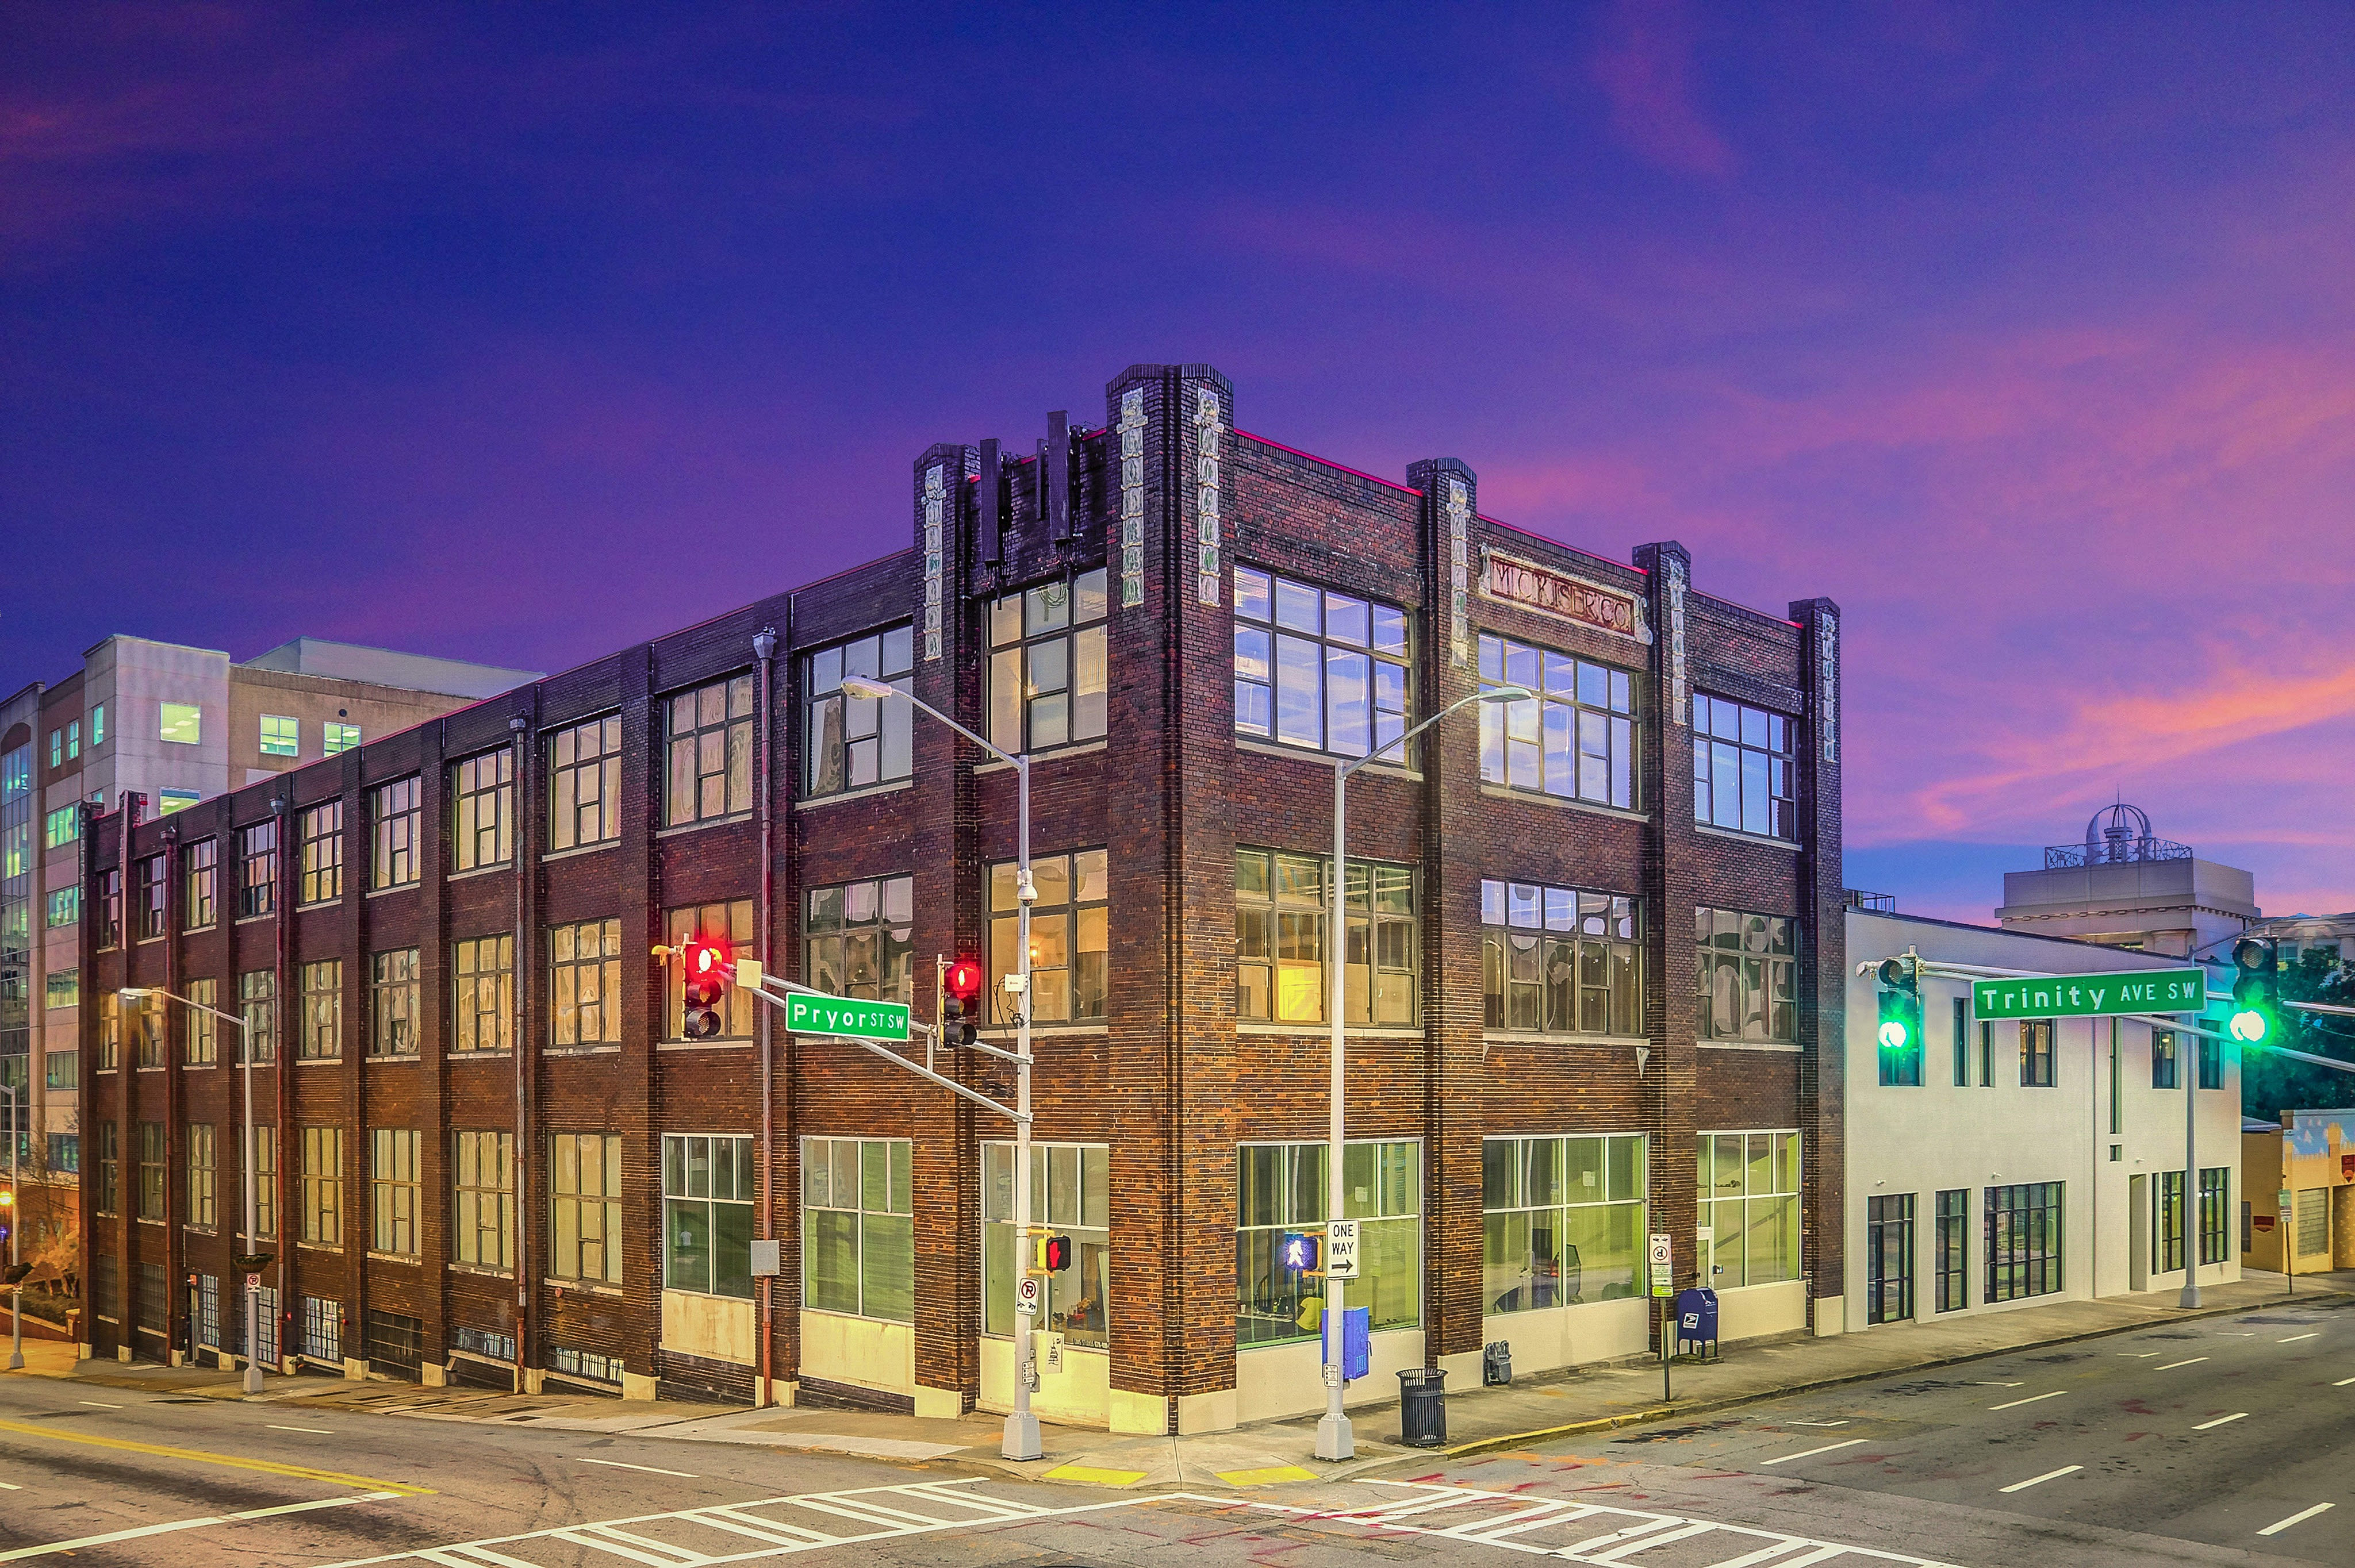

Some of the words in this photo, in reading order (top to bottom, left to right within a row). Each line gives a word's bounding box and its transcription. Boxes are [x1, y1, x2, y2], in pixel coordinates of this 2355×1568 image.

[1982, 985, 2105, 1010] Trinity
[2120, 984, 2156, 1002] AVE
[2168, 982, 2196, 1000] SW
[794, 1004, 866, 1029] Pryor
[870, 1013, 885, 1027] ST
[888, 1014, 904, 1029] SW
[1333, 1224, 1353, 1237] ONE
[1332, 1242, 1354, 1255] WAY
